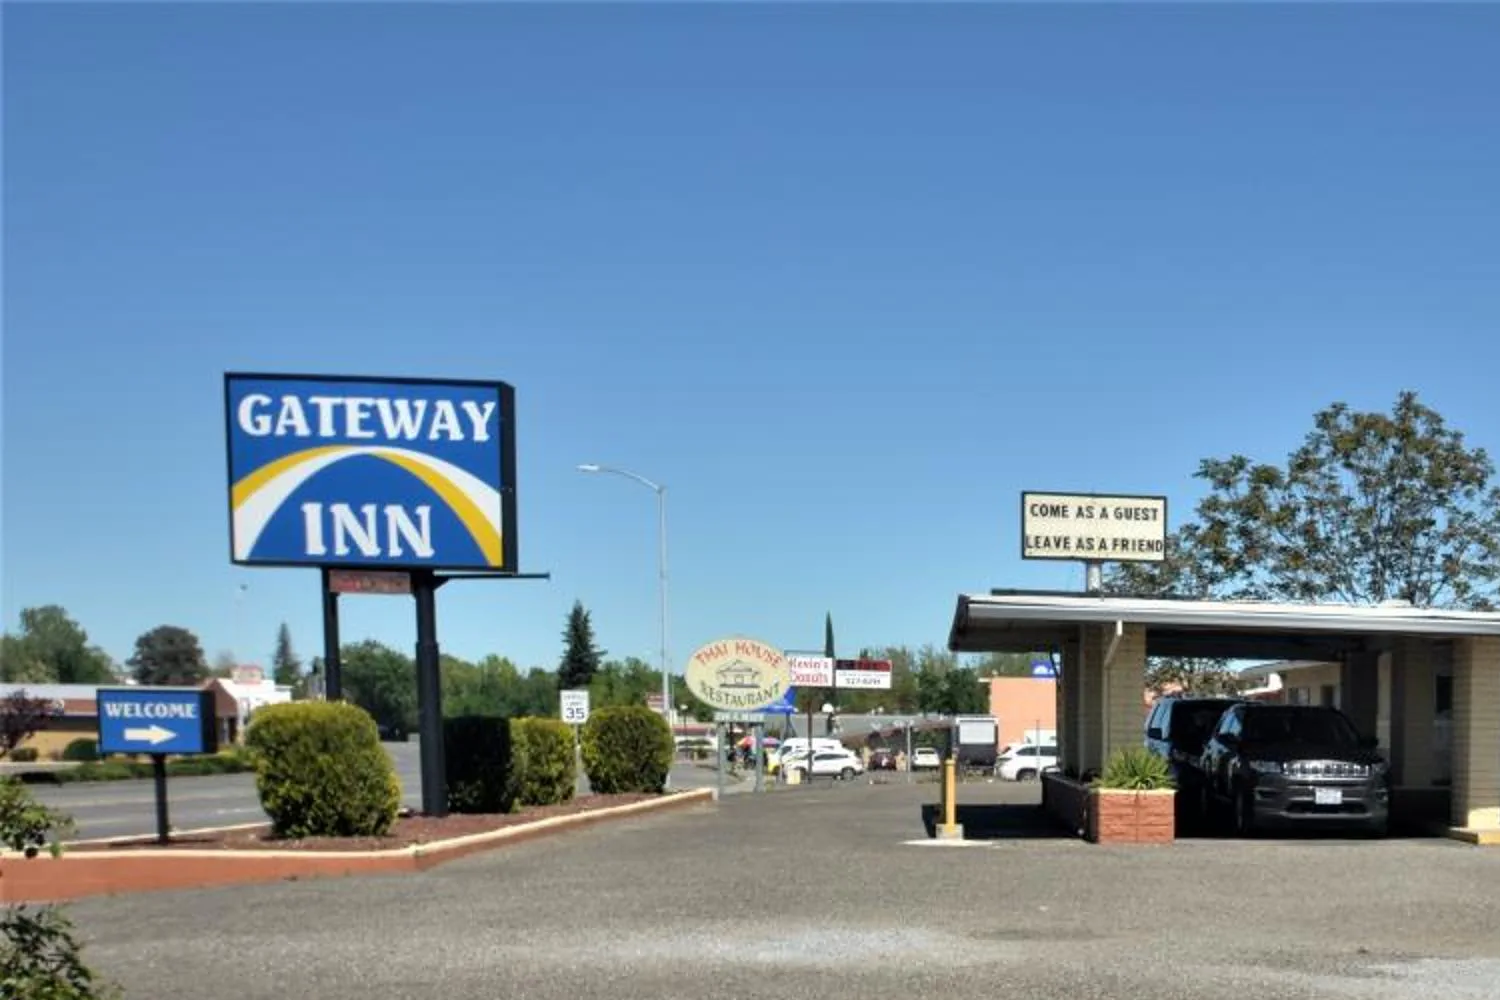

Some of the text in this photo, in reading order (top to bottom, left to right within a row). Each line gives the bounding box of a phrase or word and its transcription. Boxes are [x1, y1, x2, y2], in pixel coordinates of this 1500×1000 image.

[238, 394, 496, 442] GATEWAY
[1030, 504, 1158, 521] COME AS A GUEST
[302, 502, 435, 558] INN
[1025, 535, 1163, 553] LEAVE AS A FRIEND
[695, 641, 782, 668] THAI HOUSE
[104, 703, 199, 718] WELCOME
[566, 707, 585, 719] 35
